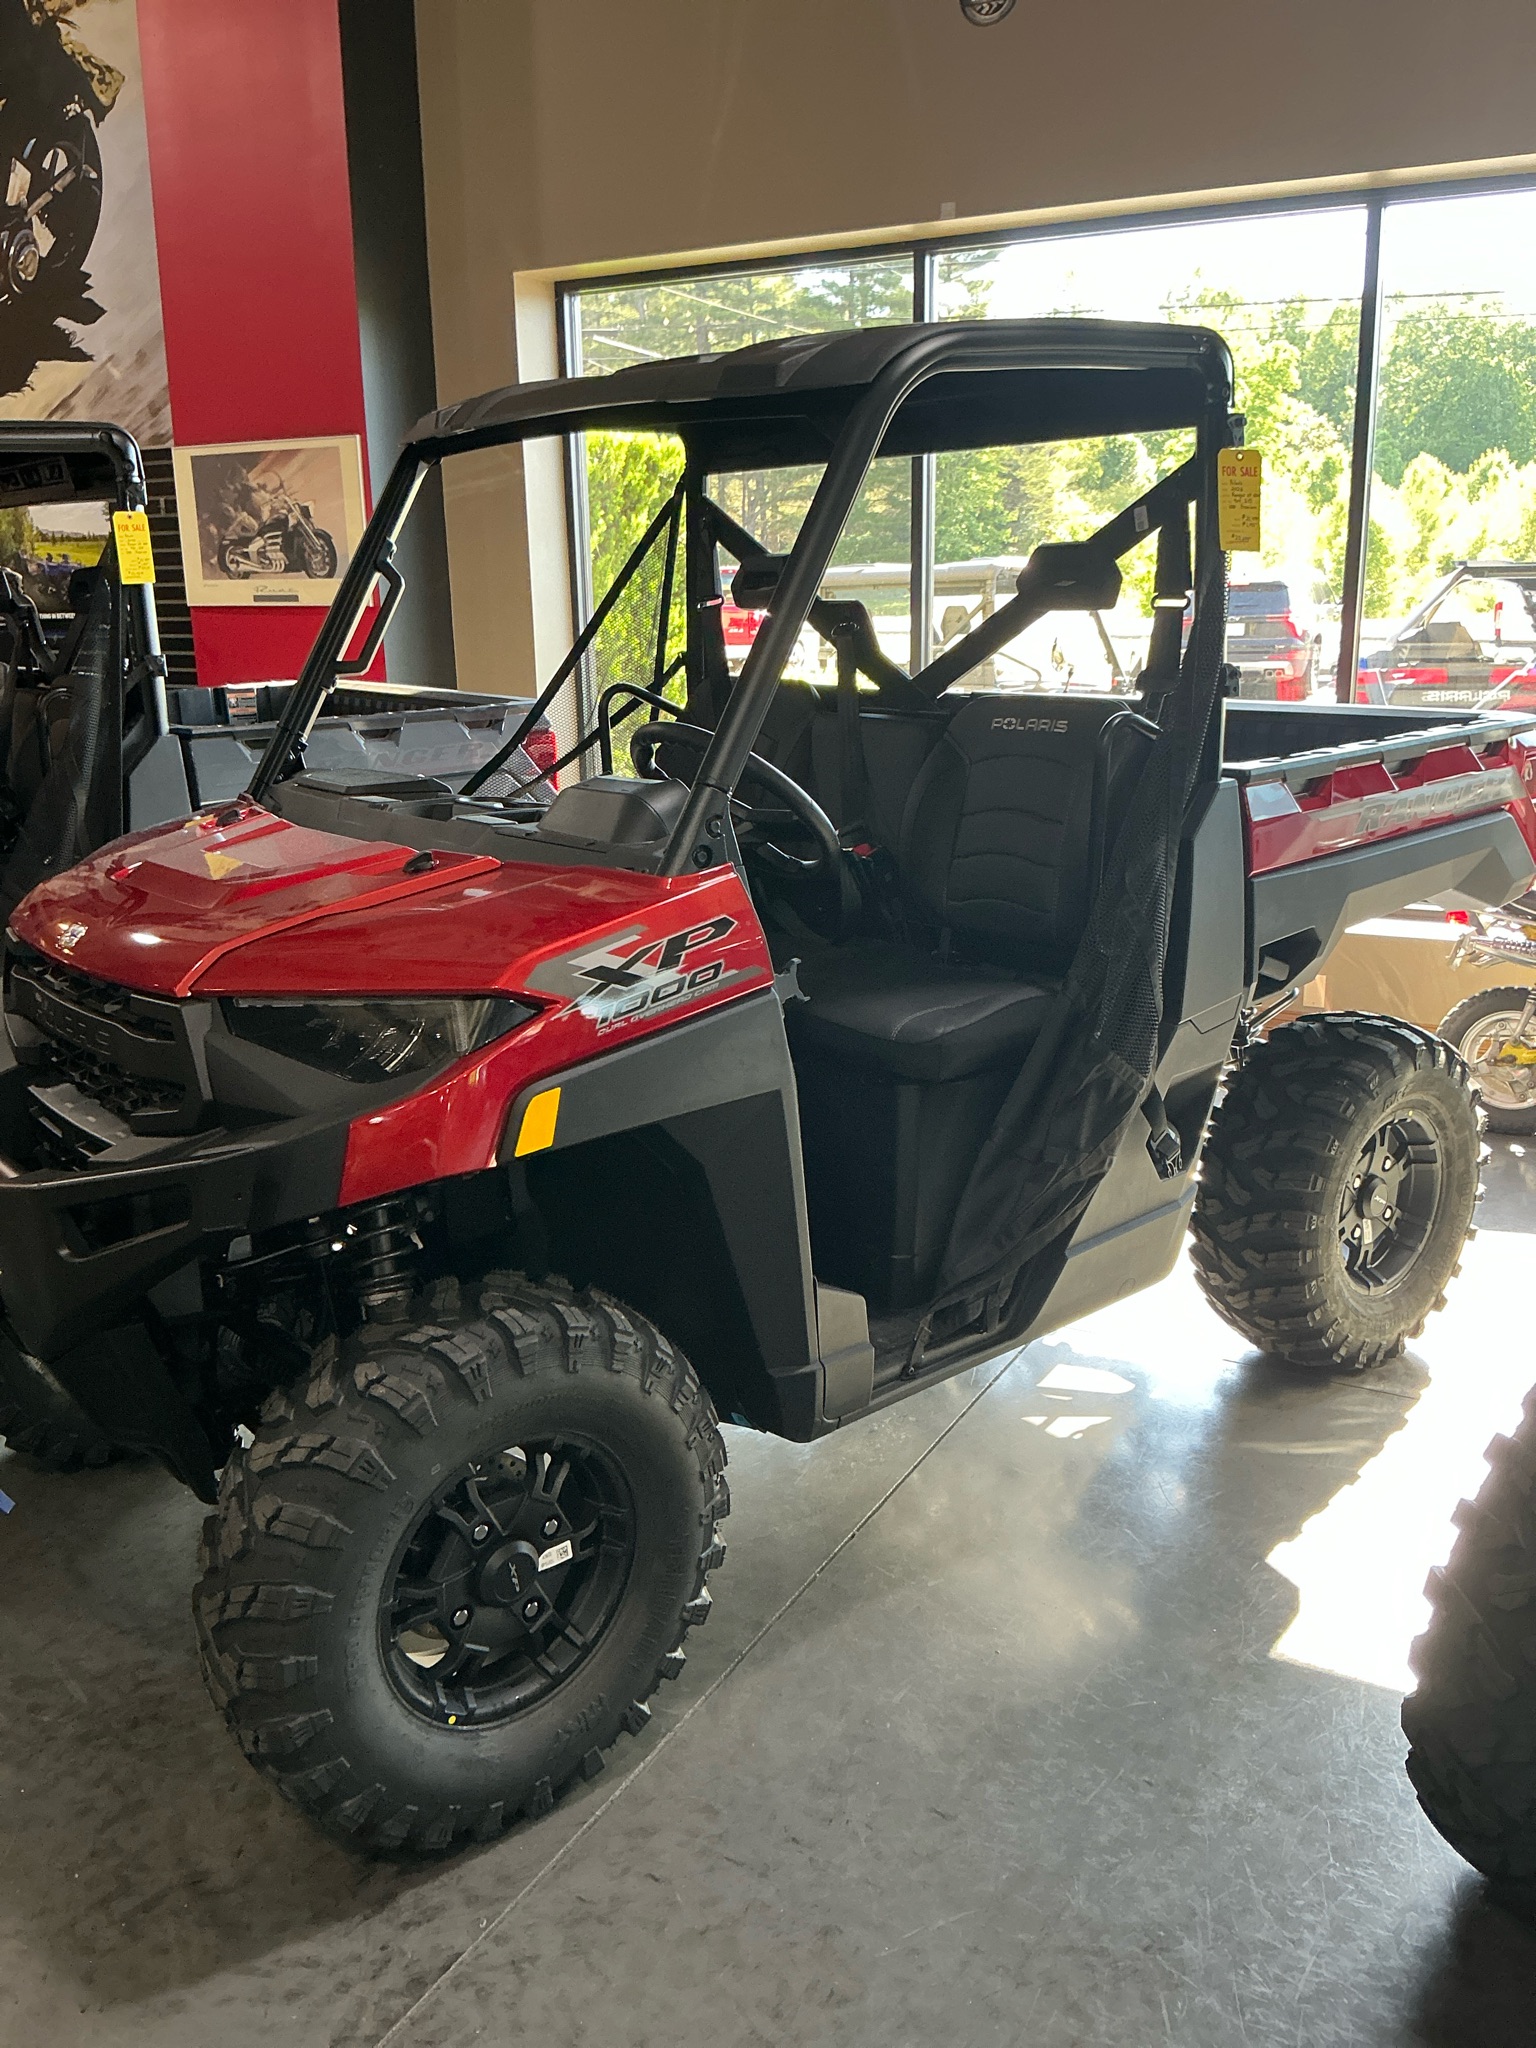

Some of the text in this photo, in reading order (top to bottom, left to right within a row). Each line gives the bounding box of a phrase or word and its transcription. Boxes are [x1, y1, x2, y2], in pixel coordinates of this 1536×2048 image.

[1222, 466, 1258, 477] FOR SALE
[118, 524, 146, 532] FOR SALE
[991, 717, 1068, 733] POLARIS
[1353, 777, 1508, 836] RANGER
[551, 914, 739, 1020] XP
[596, 960, 725, 1029] 1000
[597, 982, 719, 1036] DUAL OVERHEAD CAM
[508, 1562, 520, 1593] XP
